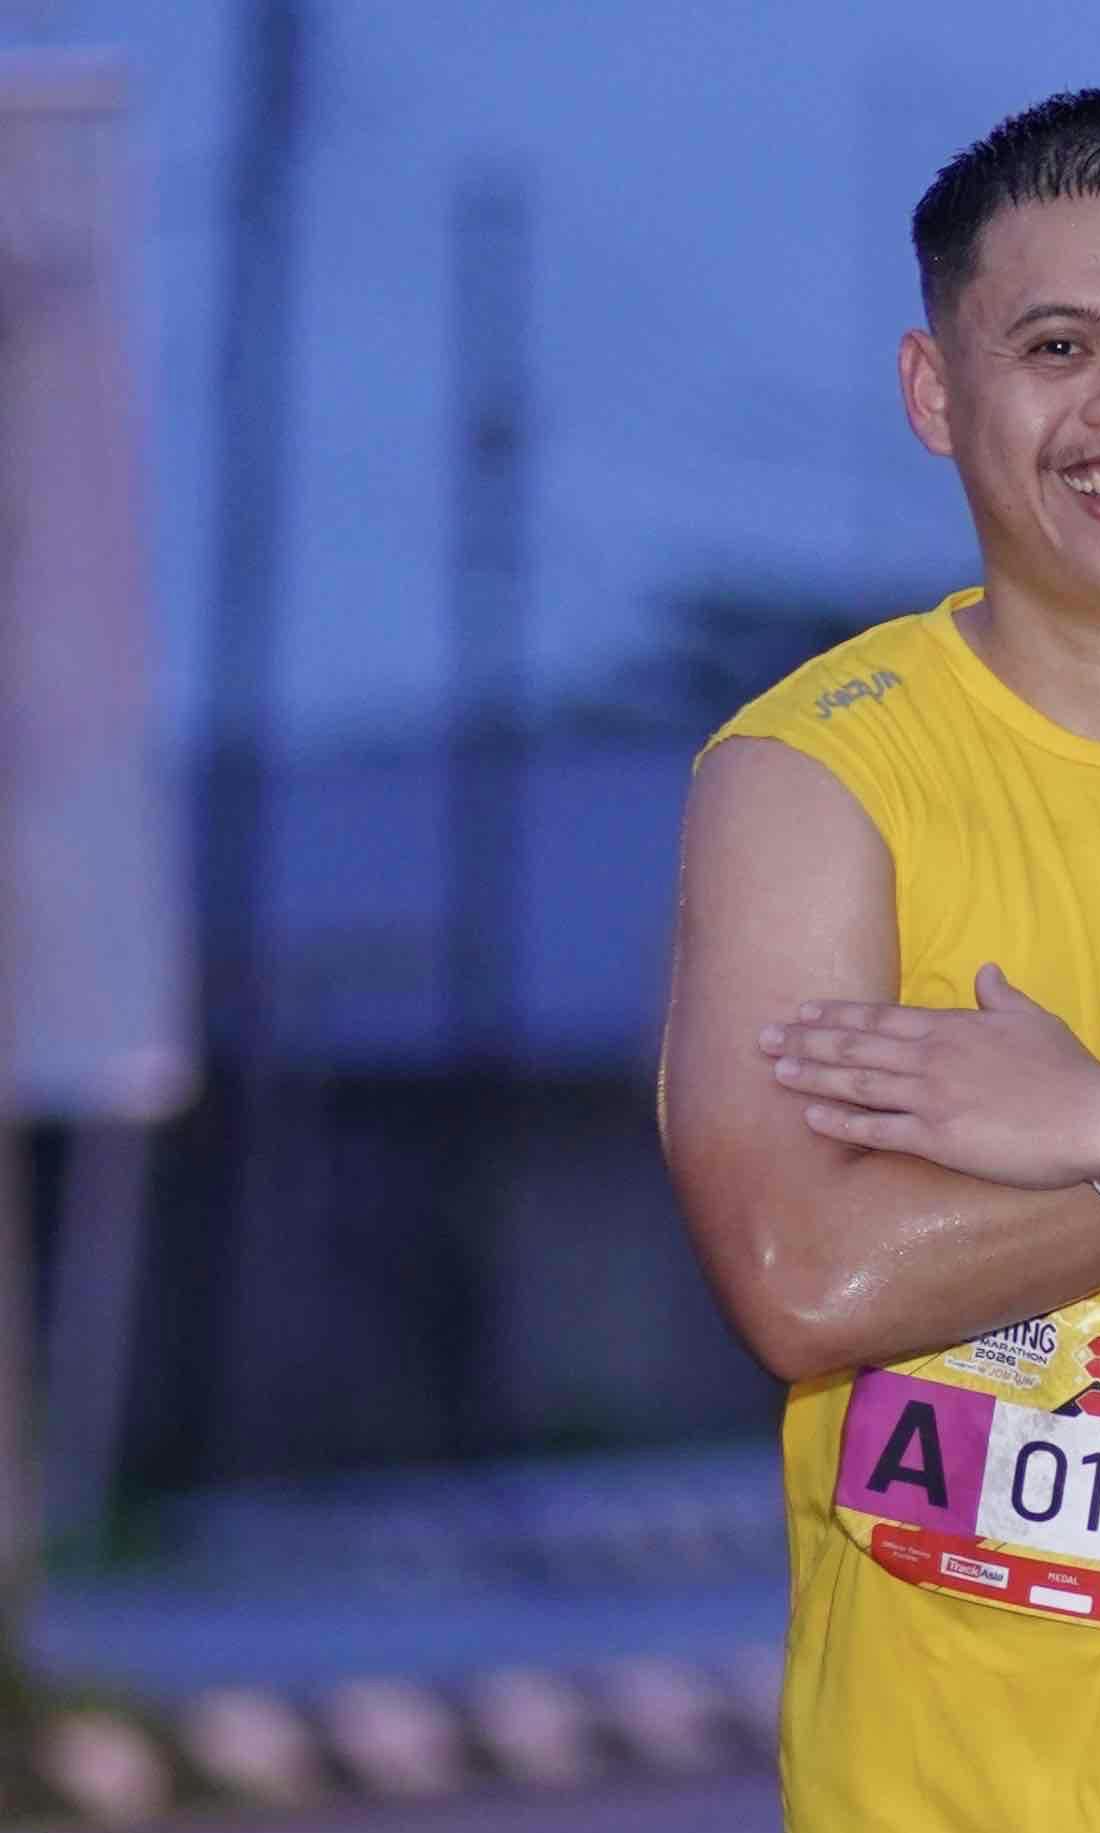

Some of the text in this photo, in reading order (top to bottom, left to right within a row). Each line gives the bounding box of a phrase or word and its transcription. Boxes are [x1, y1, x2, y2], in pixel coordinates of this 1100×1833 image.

[975, 1348, 1017, 1367] 2026
[979, 1338, 1049, 1365] MARATHON
[866, 1400, 949, 1508] A
[1048, 1572, 1080, 1585] MEDAL
